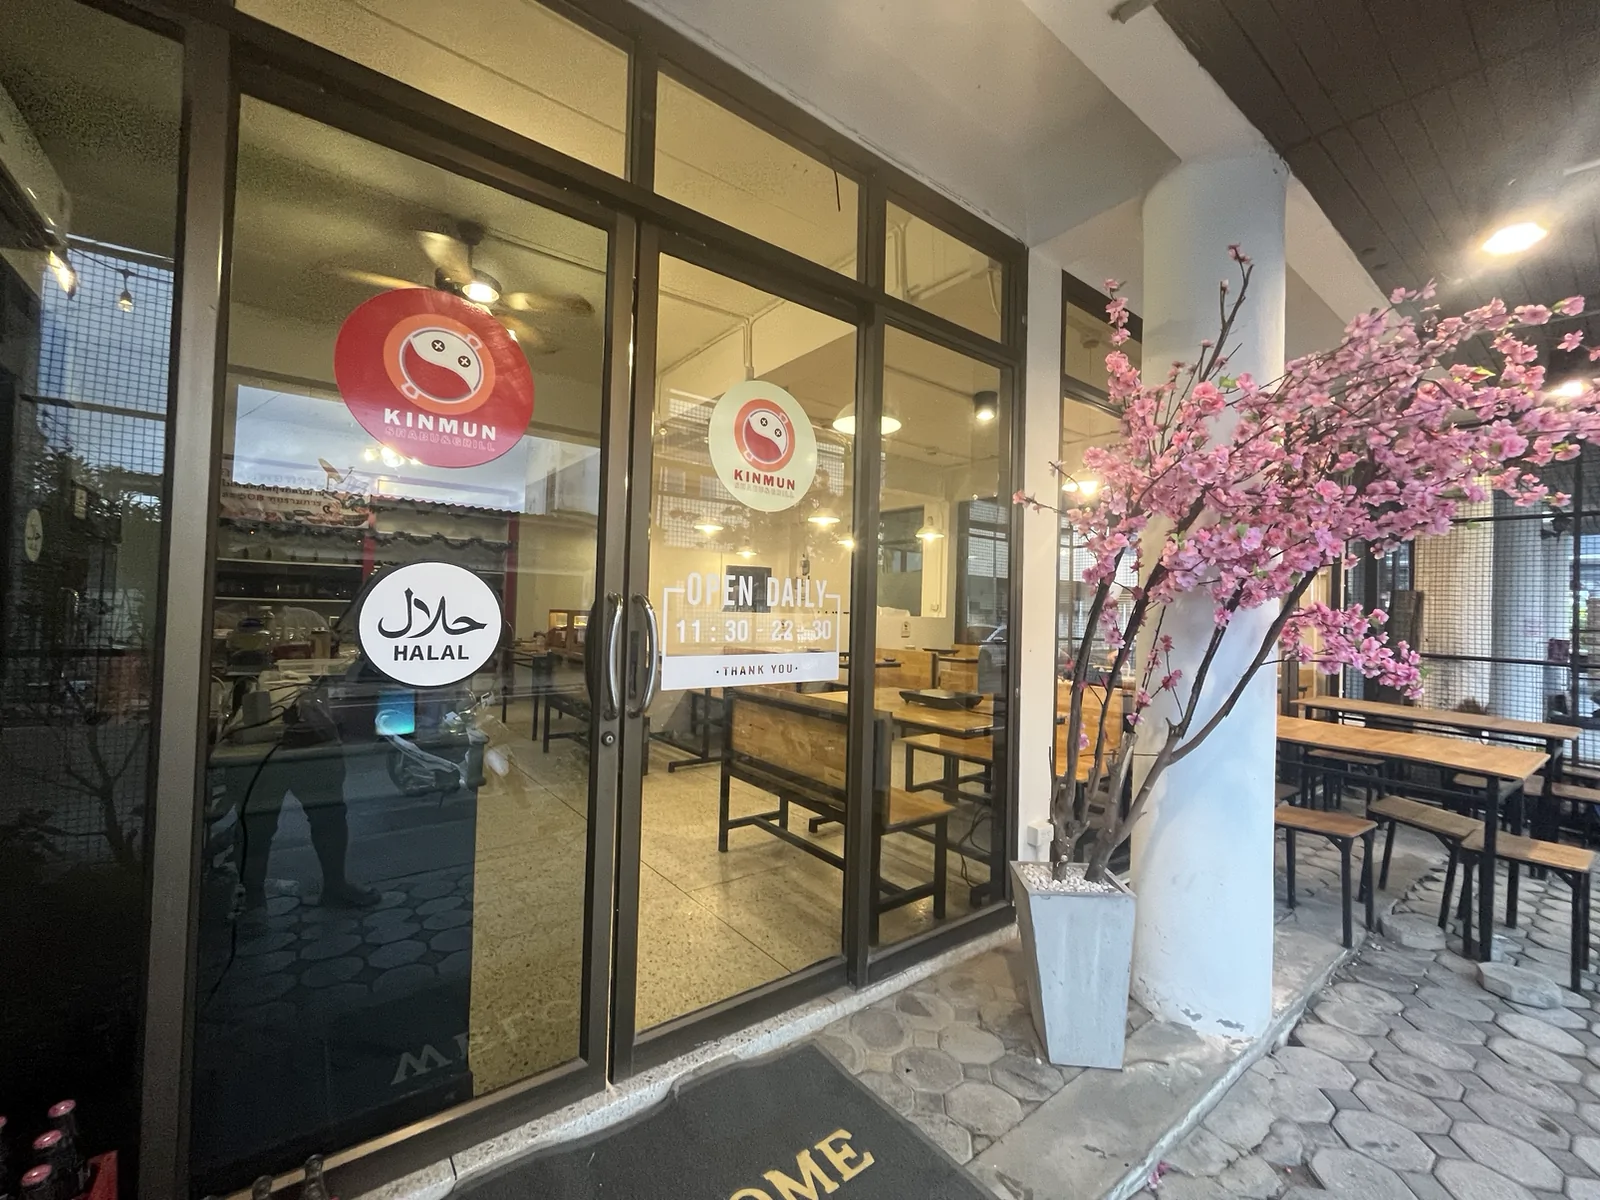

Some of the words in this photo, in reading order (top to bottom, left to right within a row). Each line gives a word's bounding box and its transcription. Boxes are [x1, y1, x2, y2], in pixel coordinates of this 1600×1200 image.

[384, 408, 497, 441] KINMUN
[384, 426, 496, 452] SHABU&GRILL
[734, 468, 795, 490] KINMUN
[687, 572, 753, 607] OPEN
[767, 576, 828, 608] DAILY
[377, 587, 488, 639] حلال
[393, 644, 470, 662] HALAL
[722, 664, 765, 677] THANK
[771, 663, 794, 675] YOU
